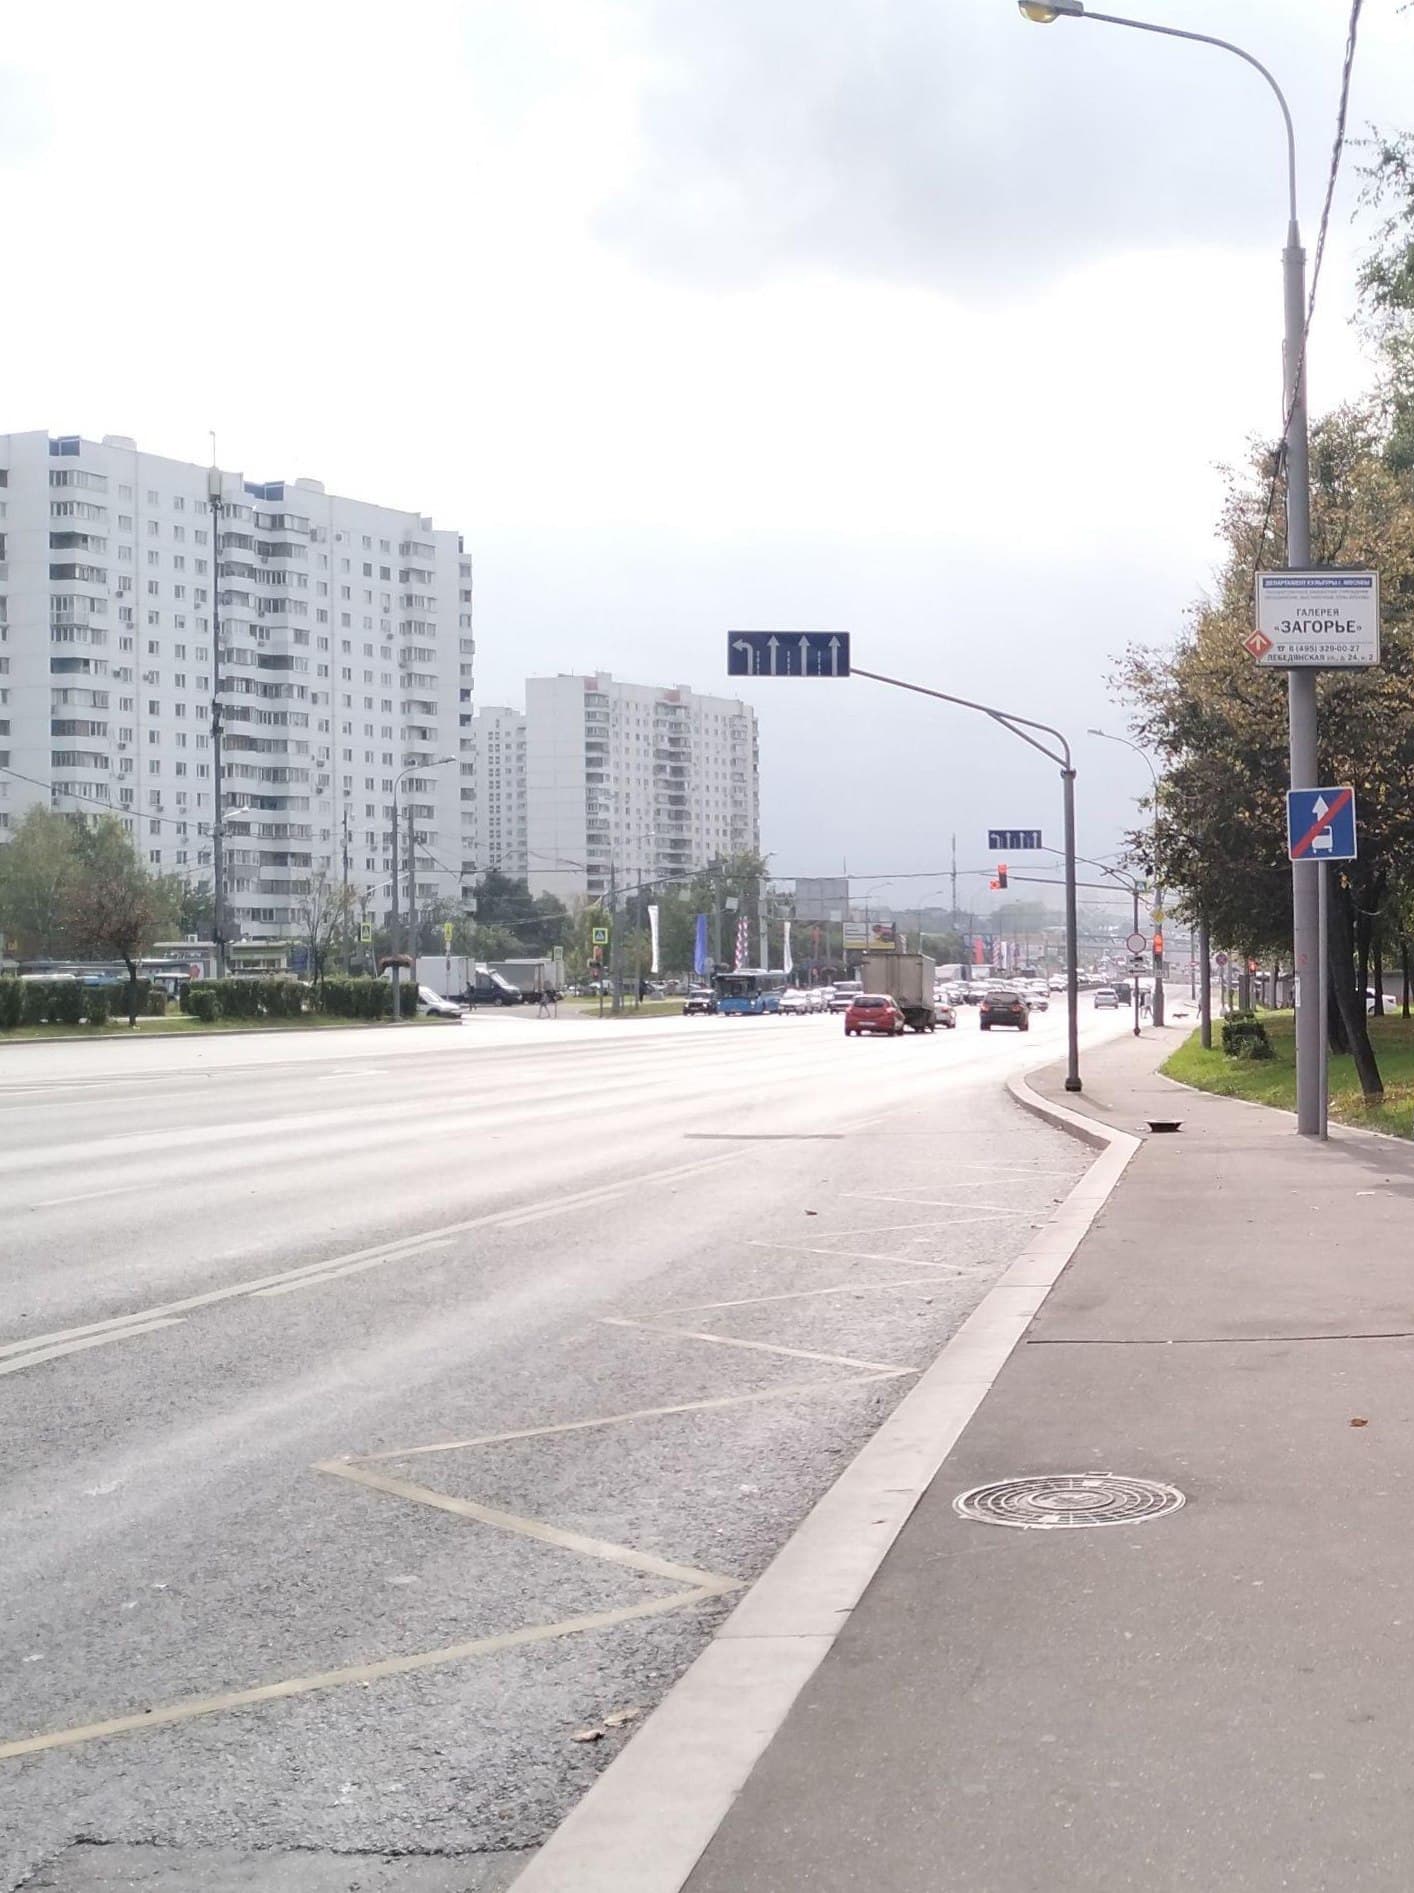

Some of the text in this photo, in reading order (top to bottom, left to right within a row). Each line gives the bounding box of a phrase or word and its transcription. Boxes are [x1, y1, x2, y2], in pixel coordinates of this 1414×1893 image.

[1296, 608, 1340, 617] ГАЛЕРЕЯ
[1274, 620, 1362, 634] «ЗАГОРЬЕ»
[1267, 654, 1326, 662] ЛЕБЕДЯНСКАЯ
